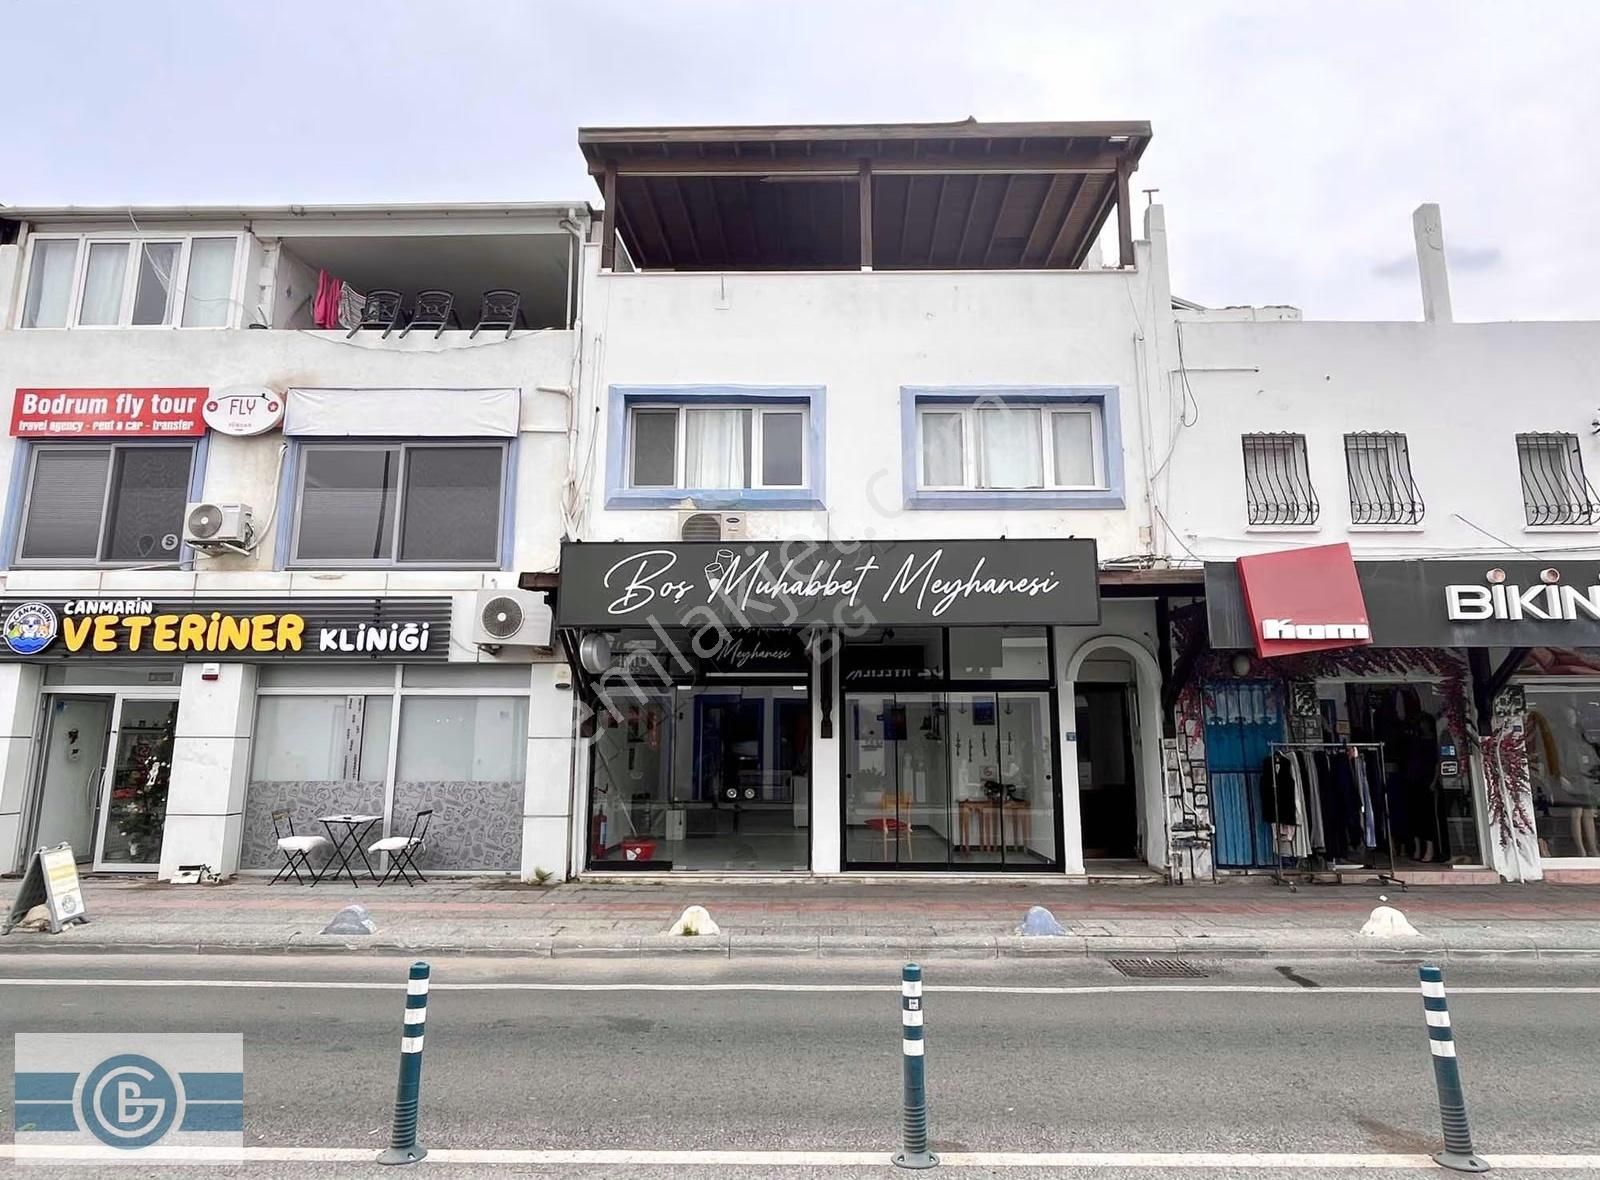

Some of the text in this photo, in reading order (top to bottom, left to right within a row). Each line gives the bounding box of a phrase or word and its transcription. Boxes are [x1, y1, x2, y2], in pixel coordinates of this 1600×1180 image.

[22, 393, 197, 418] Bodrum fly tour
[230, 398, 256, 415] FLY
[18, 420, 47, 431] travel
[49, 421, 84, 433] agency
[92, 420, 115, 431] rent
[116, 422, 123, 431] a
[125, 421, 144, 431] car
[152, 420, 194, 431] transfer
[707, 550, 879, 611] Muhabbet
[882, 549, 1060, 616] Meyhanesi
[1445, 568, 1600, 620] BİKİN
[63, 598, 153, 614] CANMARİN
[63, 611, 430, 652] VETERİNER KLİNİĞİ
[1262, 618, 1370, 640] Kom
[716, 638, 792, 667] Meyhanesi
